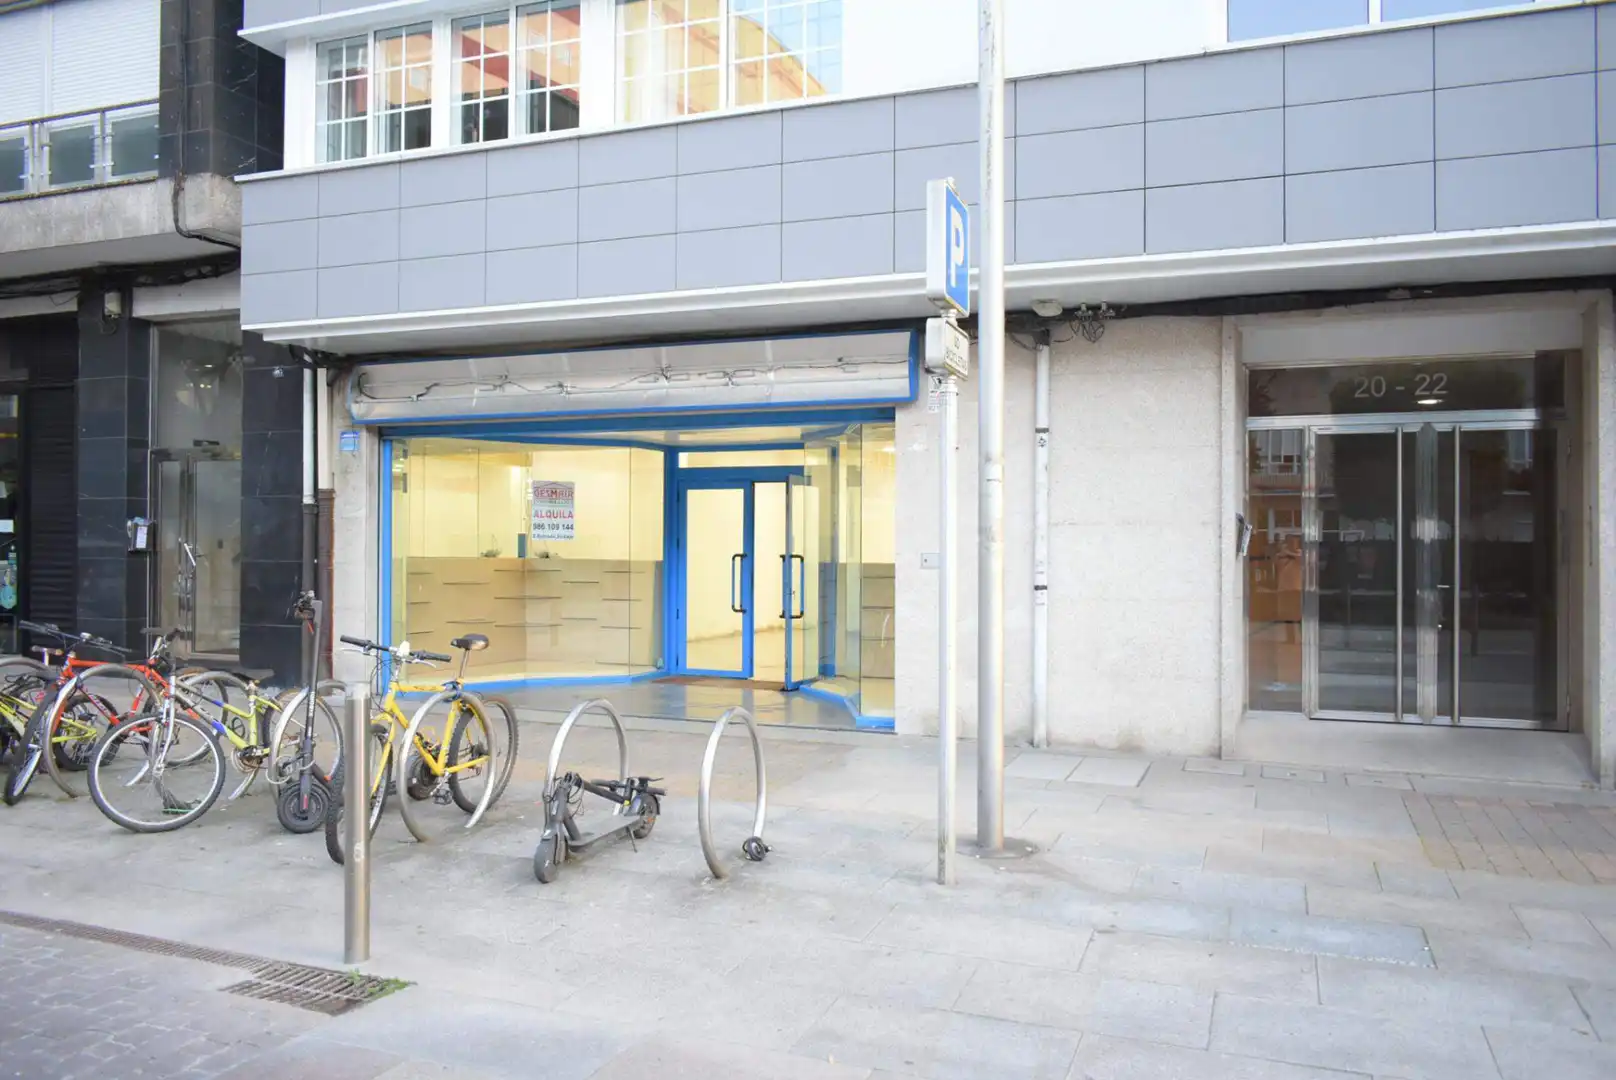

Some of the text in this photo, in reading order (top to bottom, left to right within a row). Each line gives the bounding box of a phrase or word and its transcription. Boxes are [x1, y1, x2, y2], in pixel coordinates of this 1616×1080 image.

[950, 204, 964, 288] P
[1354, 375, 1386, 398] 20
[1414, 372, 1449, 396] 22
[533, 509, 574, 519] ALQUILA
[547, 523, 560, 531] 109
[561, 523, 574, 531] 144
